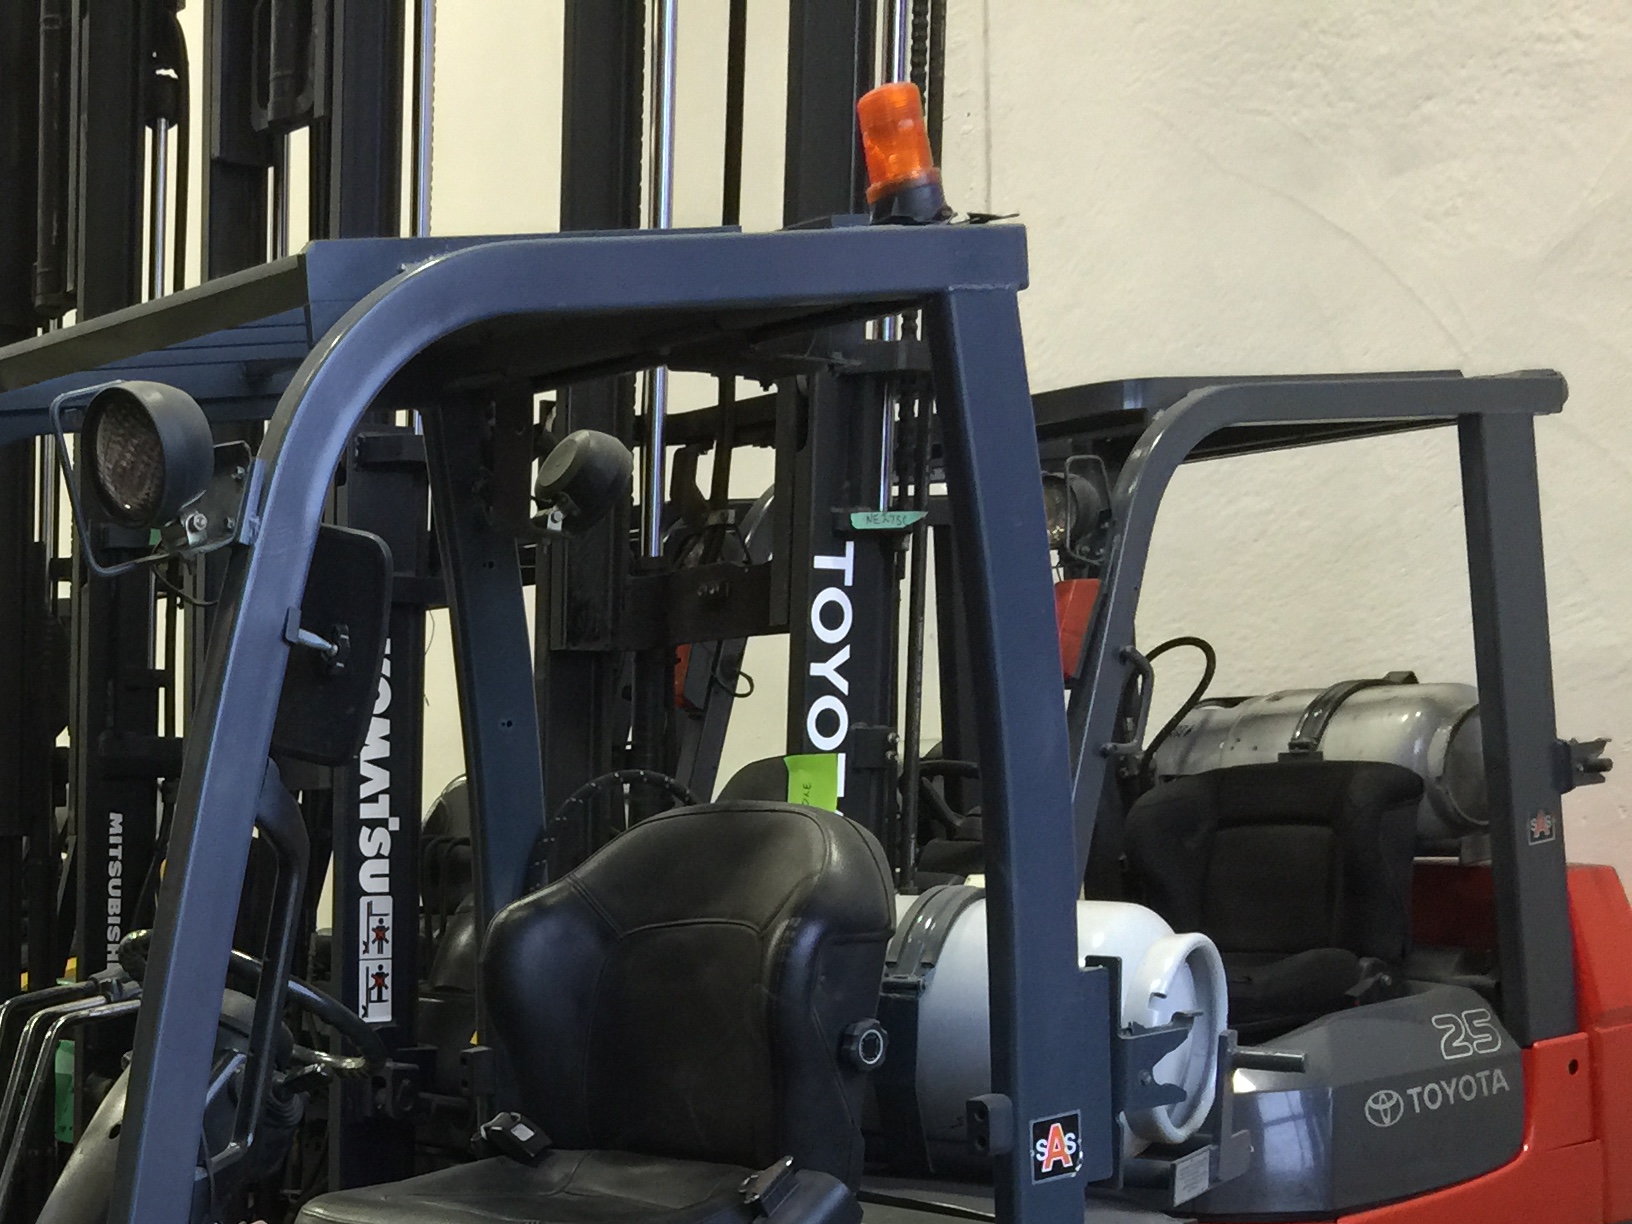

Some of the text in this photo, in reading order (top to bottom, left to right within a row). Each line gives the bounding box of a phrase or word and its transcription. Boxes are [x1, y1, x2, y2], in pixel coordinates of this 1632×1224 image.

[806, 541, 854, 816] TOYOT
[359, 638, 400, 893] OMATSU
[1530, 810, 1552, 838] SAS
[1431, 1008, 1502, 1060] 25
[1406, 1068, 1510, 1114] TOYOTA
[1035, 1122, 1077, 1173] SAS
